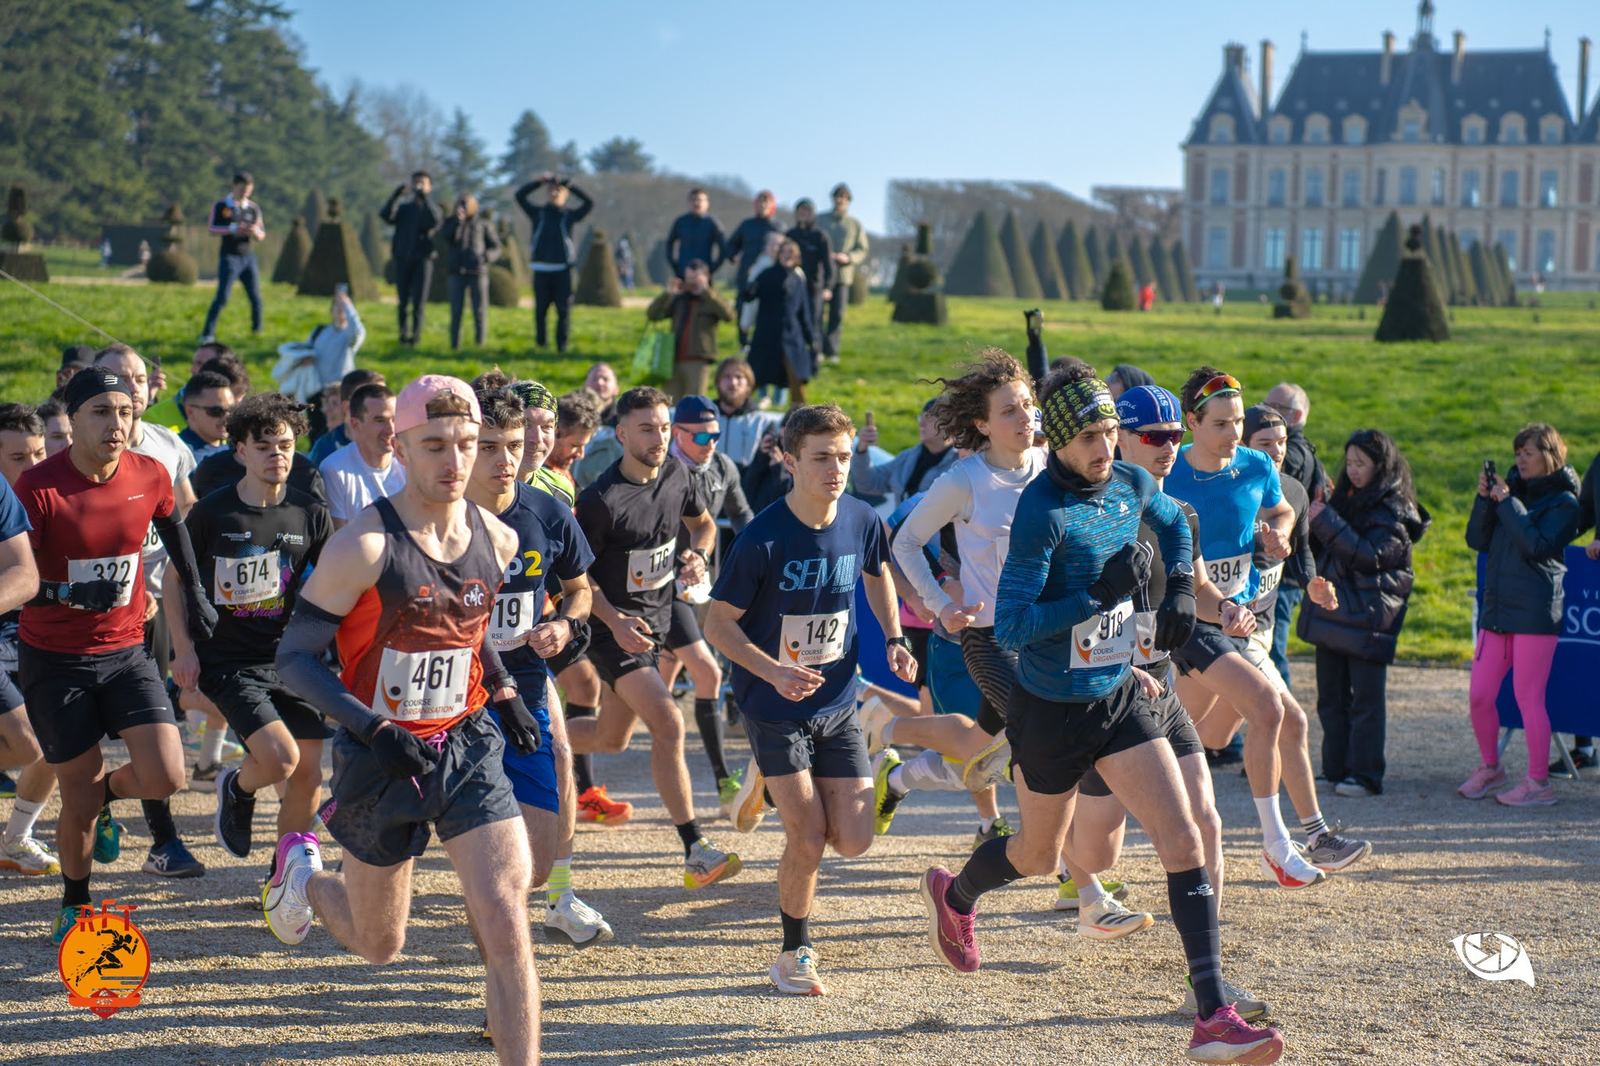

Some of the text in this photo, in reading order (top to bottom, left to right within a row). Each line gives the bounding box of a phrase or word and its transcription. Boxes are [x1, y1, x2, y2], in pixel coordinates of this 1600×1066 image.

[93, 560, 131, 584] 322
[236, 558, 269, 586] 674
[503, 550, 543, 584] p2
[1209, 559, 1241, 584] 394
[806, 618, 839, 645] 142
[1100, 611, 1123, 640] 918
[1093, 647, 1114, 656] COURSE
[411, 655, 454, 690] 461
[402, 705, 454, 716] ORGANISATION
[403, 699, 431, 707] COURSE
